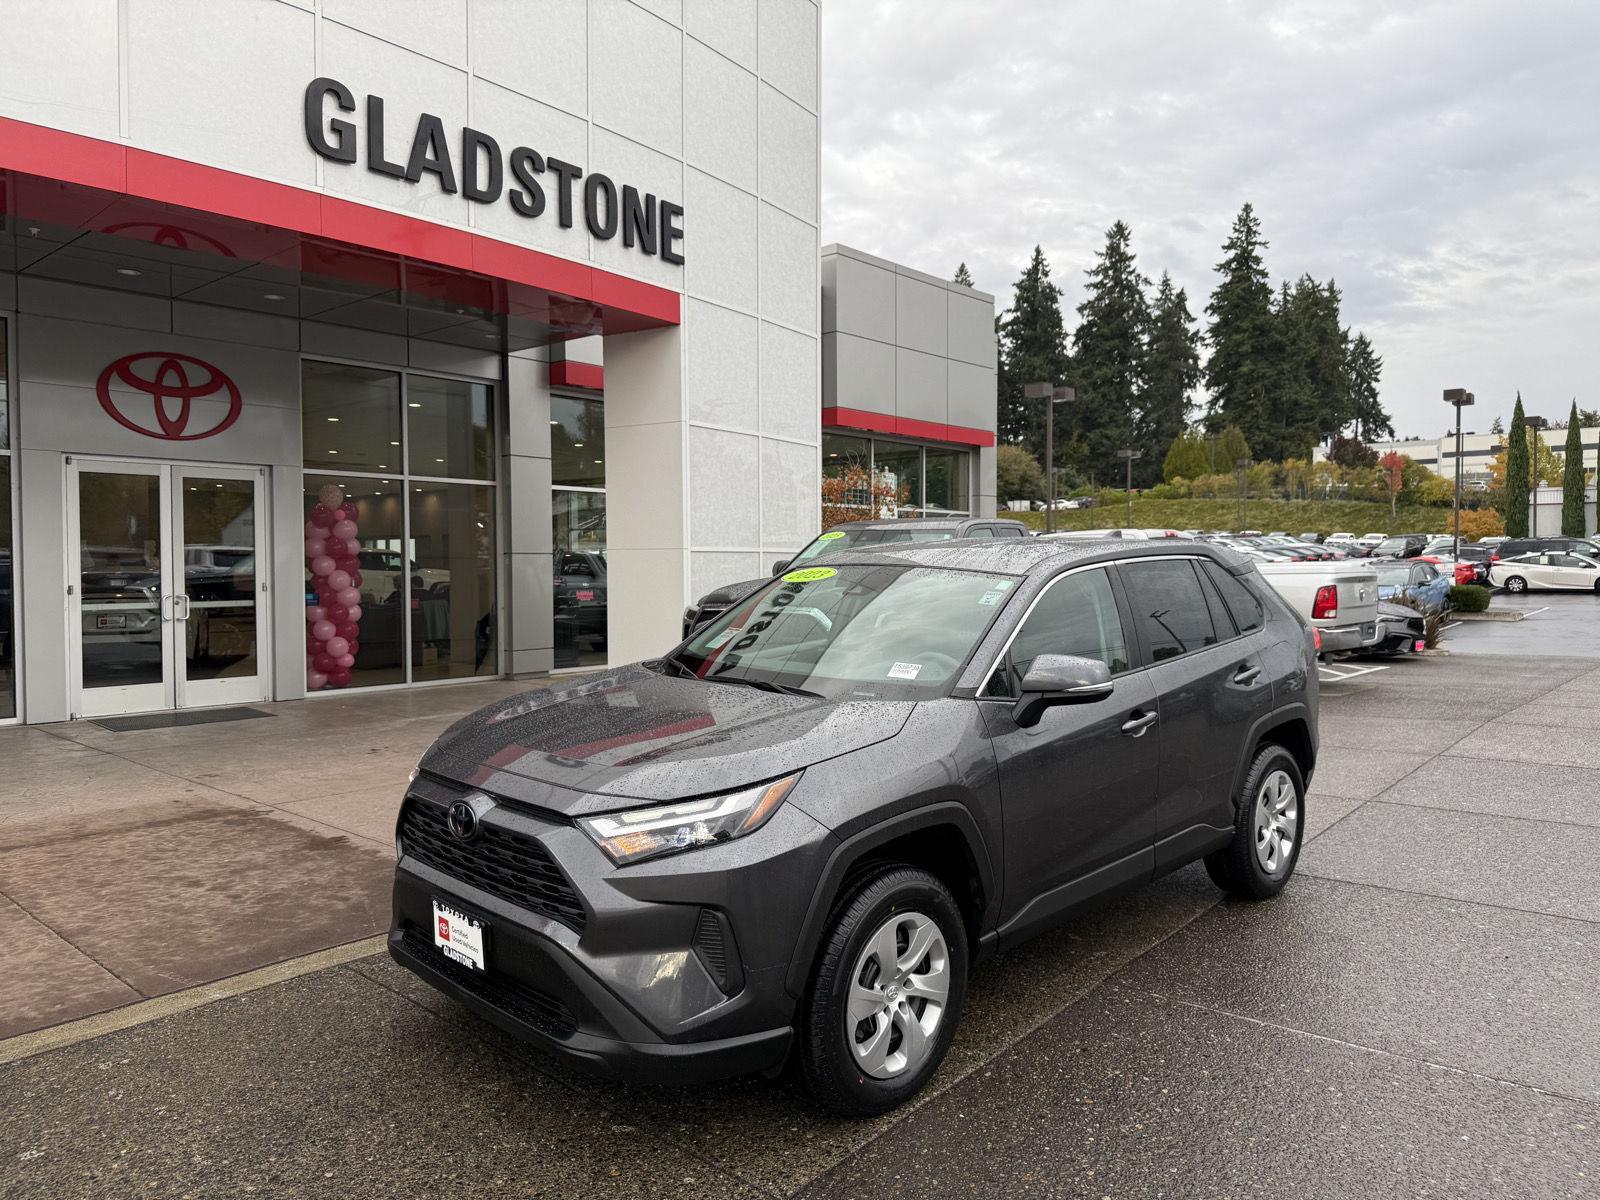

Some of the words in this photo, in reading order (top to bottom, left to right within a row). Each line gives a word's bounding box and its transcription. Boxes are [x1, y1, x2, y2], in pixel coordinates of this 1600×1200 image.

[304, 77, 685, 266] GLADSTONE
[441, 904, 470, 927] TOYOTA
[451, 925, 469, 940] Certified
[443, 945, 474, 970] GLADSTONE
